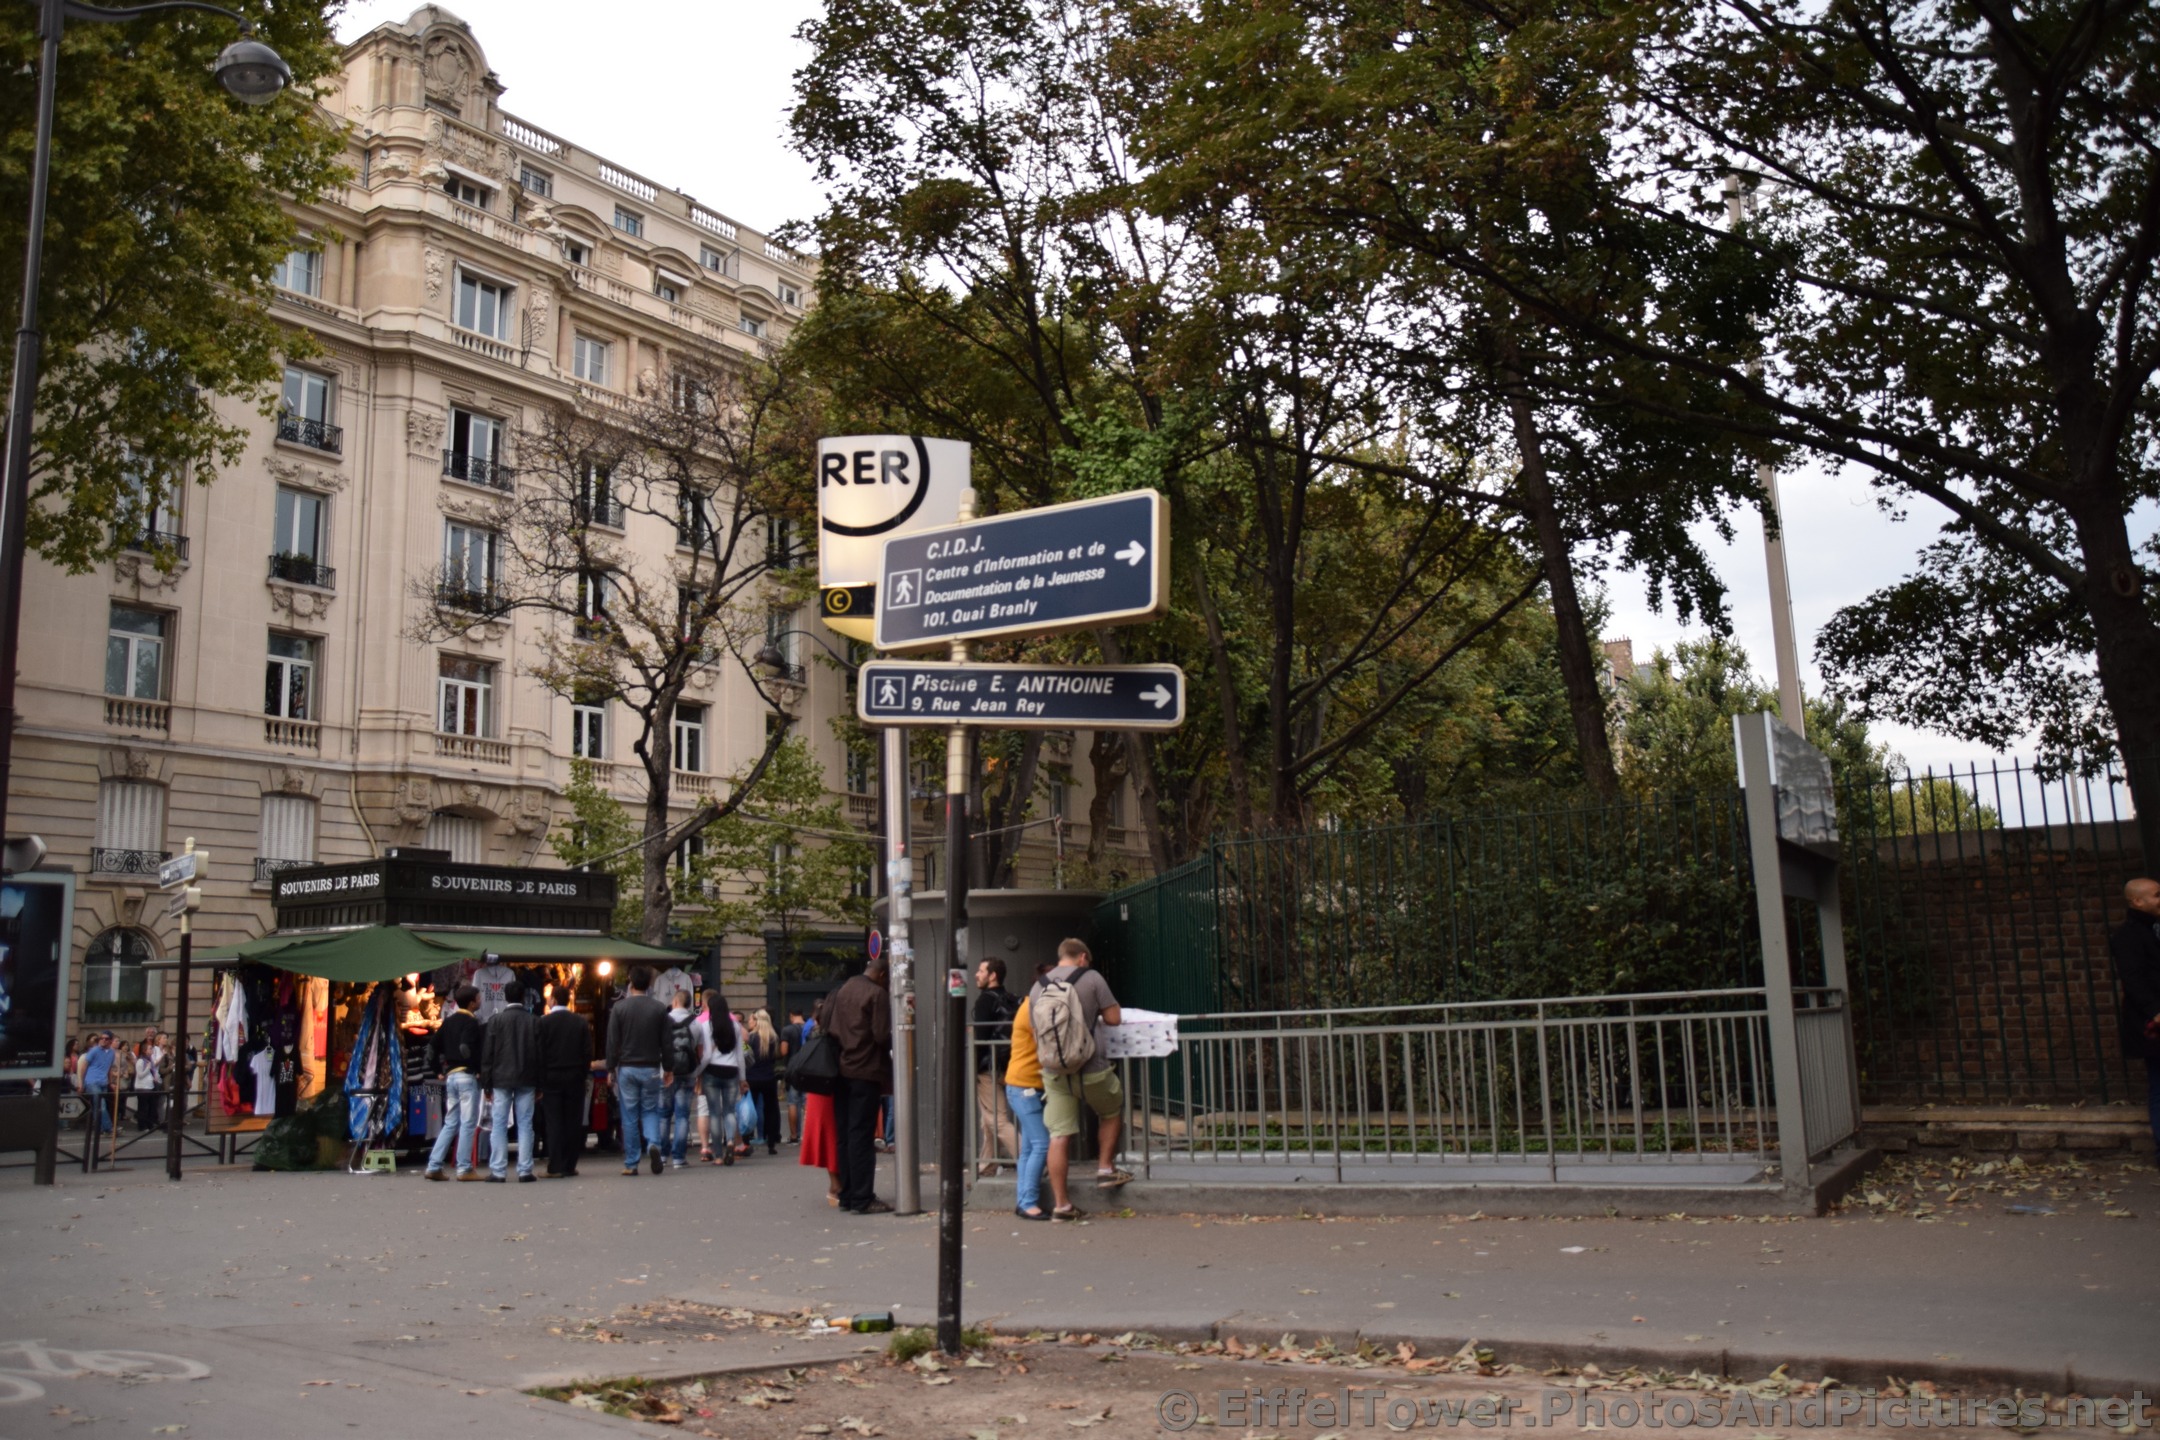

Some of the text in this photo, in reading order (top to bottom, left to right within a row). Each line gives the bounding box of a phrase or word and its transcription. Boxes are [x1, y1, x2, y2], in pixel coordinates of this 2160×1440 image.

[821, 450, 910, 487] RER
[927, 535, 985, 560] C.I.D.J.
[925, 541, 1105, 582] Centre d'Information et de
[924, 567, 1105, 605] Documentation de la Jeunesse
[951, 605, 985, 623] Quai
[989, 598, 1038, 618] Branly
[911, 674, 1114, 694] Piscine E. ANTHOINE
[931, 697, 960, 711] Rue
[970, 697, 1007, 712] Jean
[1016, 698, 1045, 715] Rey
[281, 873, 380, 895] SOUVENIRS DE PARIS
[432, 875, 577, 895] SOUVENIRS DE PARIS
